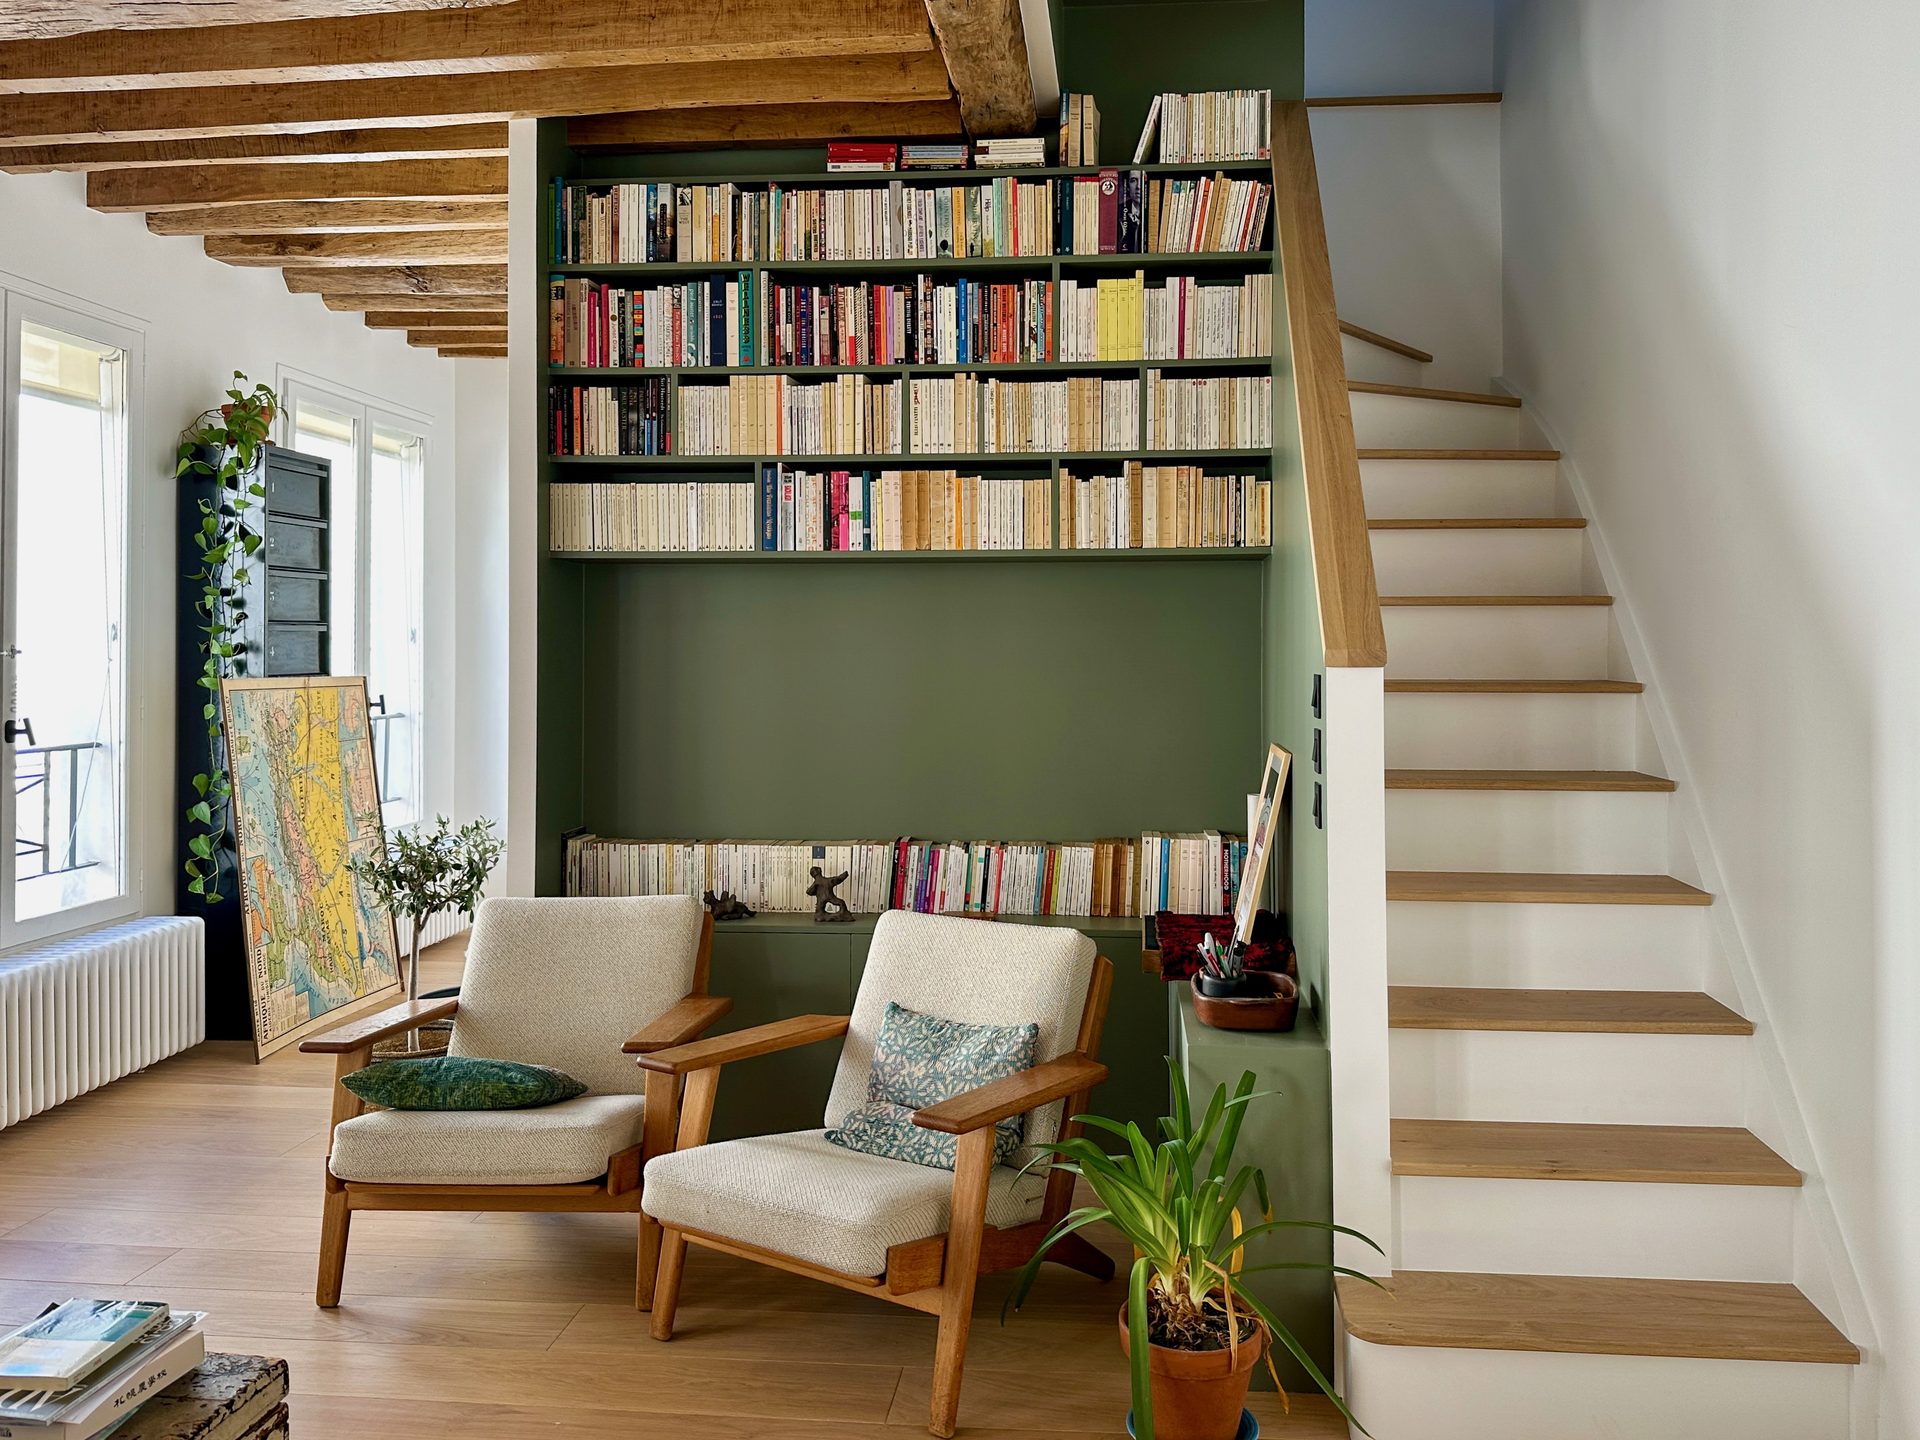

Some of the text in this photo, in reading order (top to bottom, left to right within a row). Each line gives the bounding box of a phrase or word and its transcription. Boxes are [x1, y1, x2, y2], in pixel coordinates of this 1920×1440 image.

[741, 273, 750, 343] WELLNESS
[230, 738, 238, 779] CASTELNAU
[236, 815, 244, 846] NORD
[240, 868, 250, 915] AFRIQUE
[318, 901, 327, 942] MAROC
[254, 947, 264, 979] NORD
[259, 992, 270, 1041] AFRIQUE
